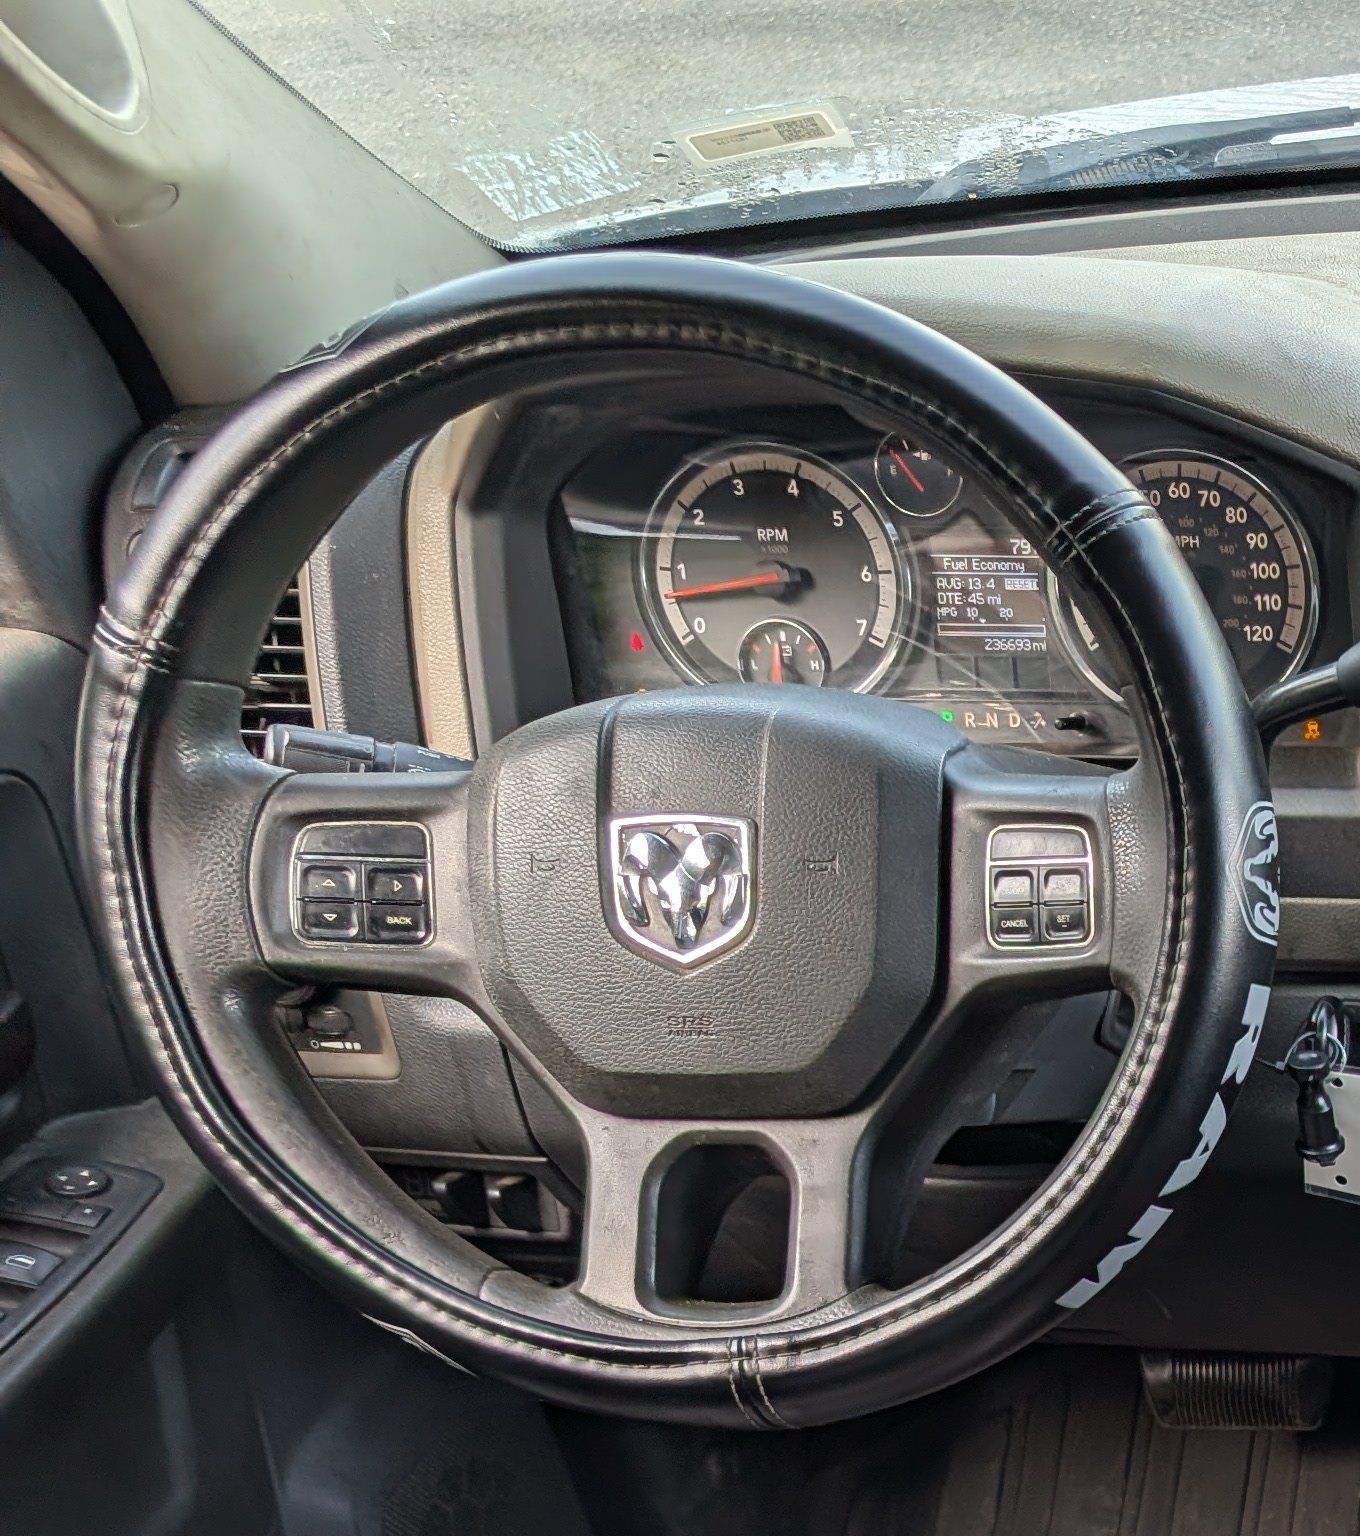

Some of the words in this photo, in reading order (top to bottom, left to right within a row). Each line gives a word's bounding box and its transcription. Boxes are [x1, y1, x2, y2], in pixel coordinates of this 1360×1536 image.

[733, 479, 745, 495] 3
[787, 480, 799, 497] 4
[1168, 482, 1190, 499] 60
[1198, 490, 1221, 507] 70
[693, 509, 705, 526] 2
[832, 511, 844, 527] 5
[1225, 507, 1247, 524] 80
[757, 528, 788, 542] RPM
[1246, 532, 1268, 550] 90
[677, 563, 687, 580] 1
[861, 565, 872, 582] 6
[943, 558, 968, 570] Fuel
[972, 558, 1025, 573] Economy
[1250, 562, 1280, 579] 100
[937, 578, 965, 589] AVG:
[968, 578, 995, 590] 13.4
[938, 593, 966, 605] DTE:
[968, 593, 985, 605] 45
[987, 593, 1002, 605] mi
[1254, 594, 1282, 611] 110
[937, 607, 958, 617] MPG
[967, 607, 979, 617] 10
[999, 607, 1014, 617] 20
[694, 617, 706, 634] 0
[856, 619, 868, 636] 7
[1244, 625, 1273, 642] 120
[811, 660, 820, 671] H
[964, 712, 976, 728] R
[986, 713, 998, 728] N
[1009, 713, 1021, 728] D
[386, 916, 413, 926] BACK
[1001, 919, 1028, 928] CANCEL
[1056, 914, 1071, 923] SET
